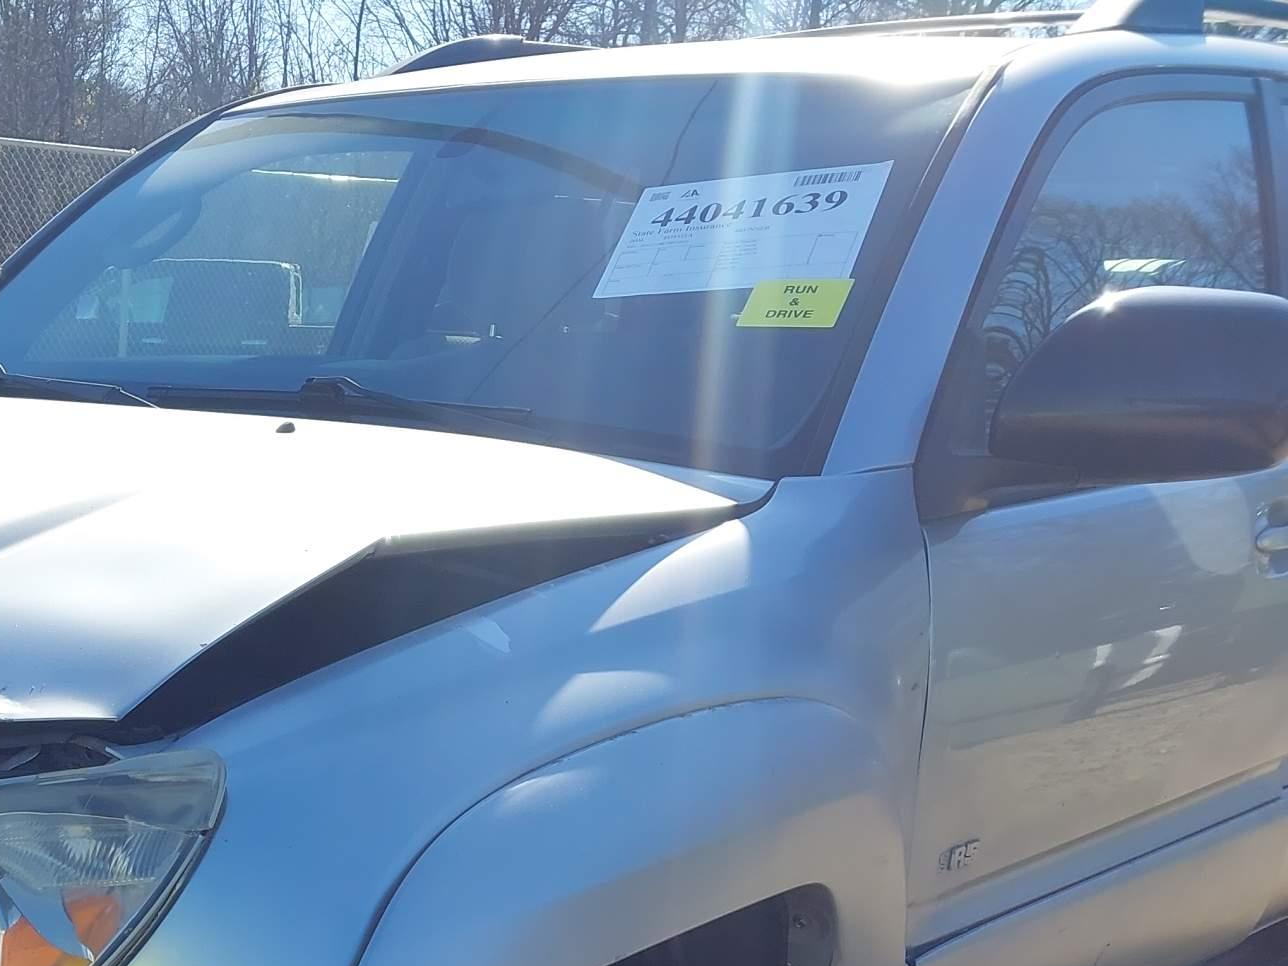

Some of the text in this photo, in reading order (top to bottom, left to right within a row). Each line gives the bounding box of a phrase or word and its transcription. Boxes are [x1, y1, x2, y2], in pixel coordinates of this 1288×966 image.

[650, 190, 849, 227] 44041639
[783, 285, 819, 294] RUN
[789, 297, 801, 306] &
[765, 309, 815, 319] DRIVE
